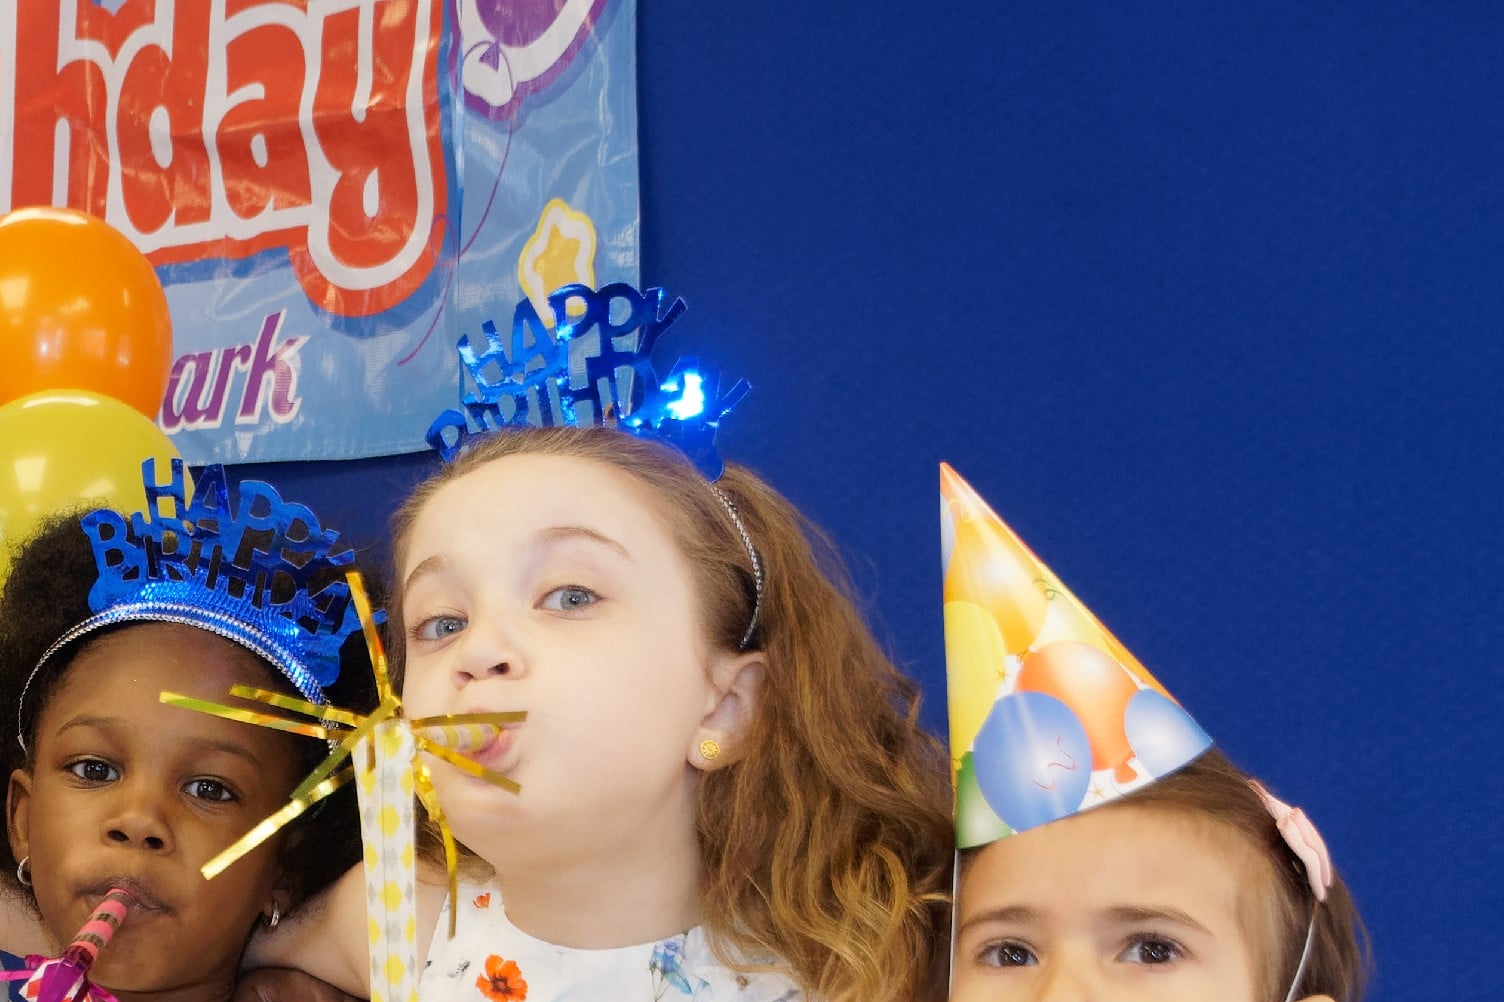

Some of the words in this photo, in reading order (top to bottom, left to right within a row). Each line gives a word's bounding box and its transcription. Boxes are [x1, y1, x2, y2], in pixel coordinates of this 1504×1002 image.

[160, 308, 309, 434] ark
[456, 282, 688, 386] HAPPY
[141, 457, 355, 568] HAPPY
